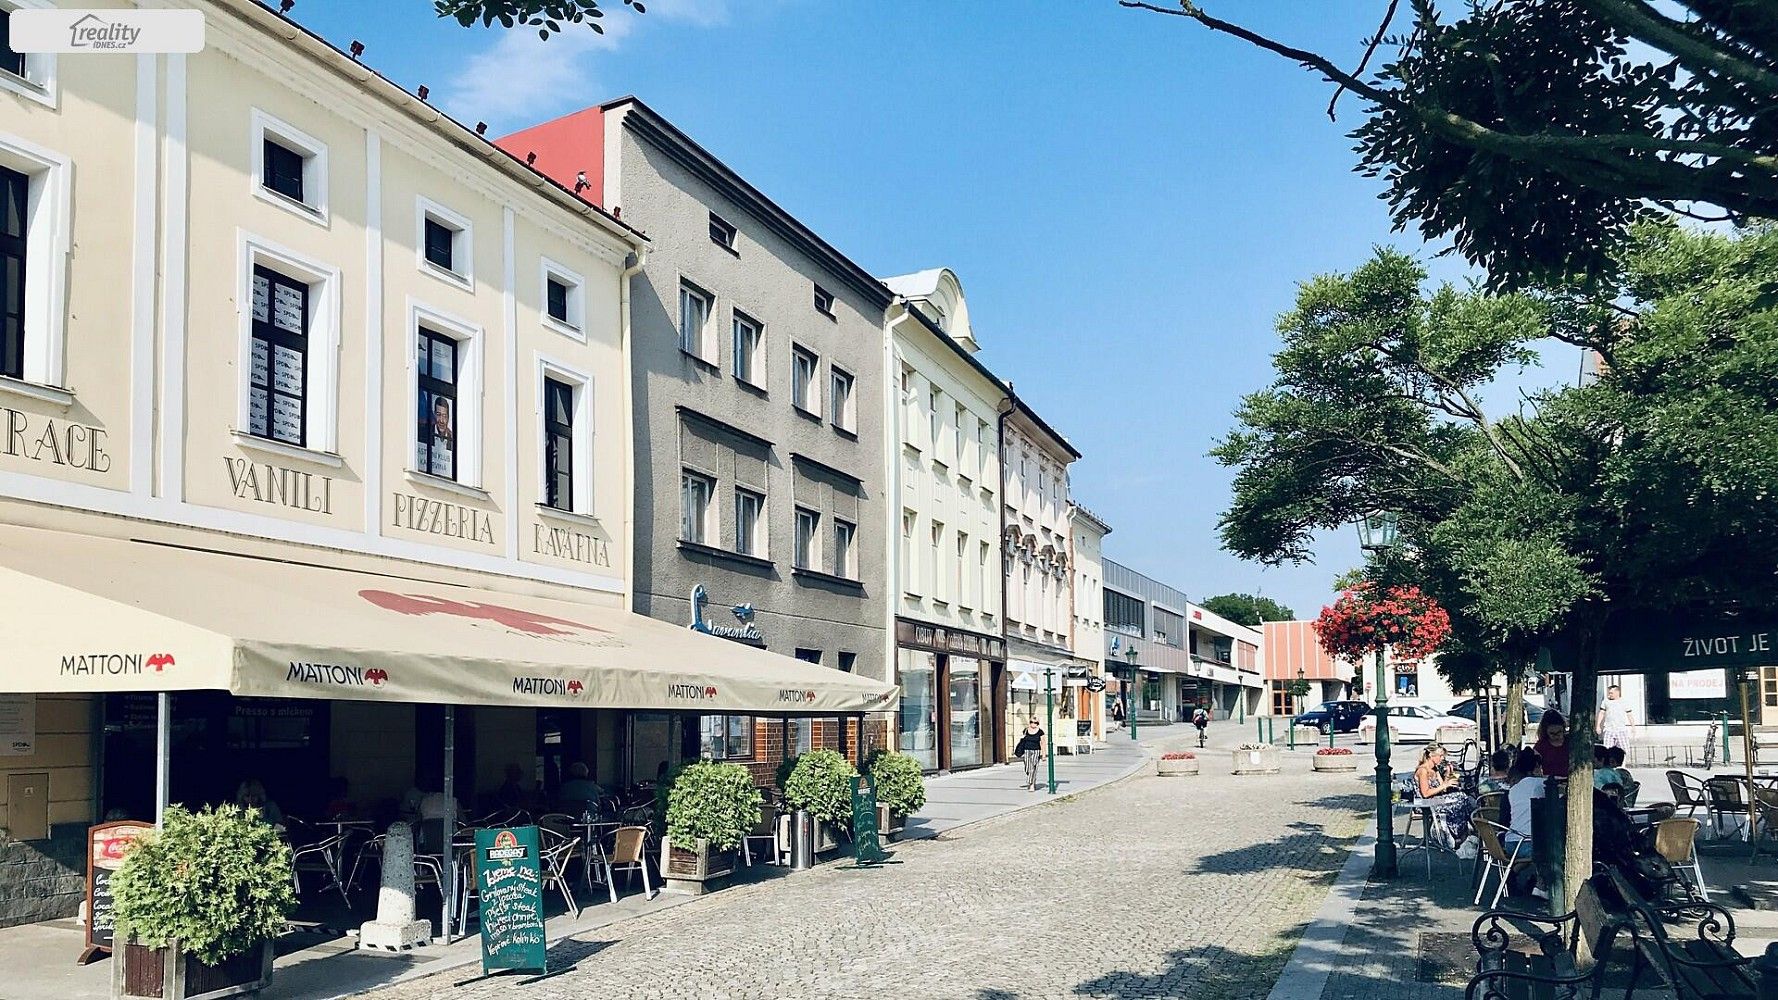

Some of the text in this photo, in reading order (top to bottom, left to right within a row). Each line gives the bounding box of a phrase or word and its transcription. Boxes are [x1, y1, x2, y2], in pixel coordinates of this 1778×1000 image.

[0, 407, 111, 473] RACE
[223, 456, 332, 515] VANILI
[392, 492, 495, 545] PIZZERIA
[533, 523, 610, 567] KAVÁRNA
[1683, 633, 1770, 656] ŽIVOT JE
[60, 653, 142, 676] MATTONI
[286, 661, 364, 686] MATTONI
[513, 677, 566, 695] MATTONI
[668, 684, 705, 699] MATTONI
[779, 690, 806, 702] MATTONI
